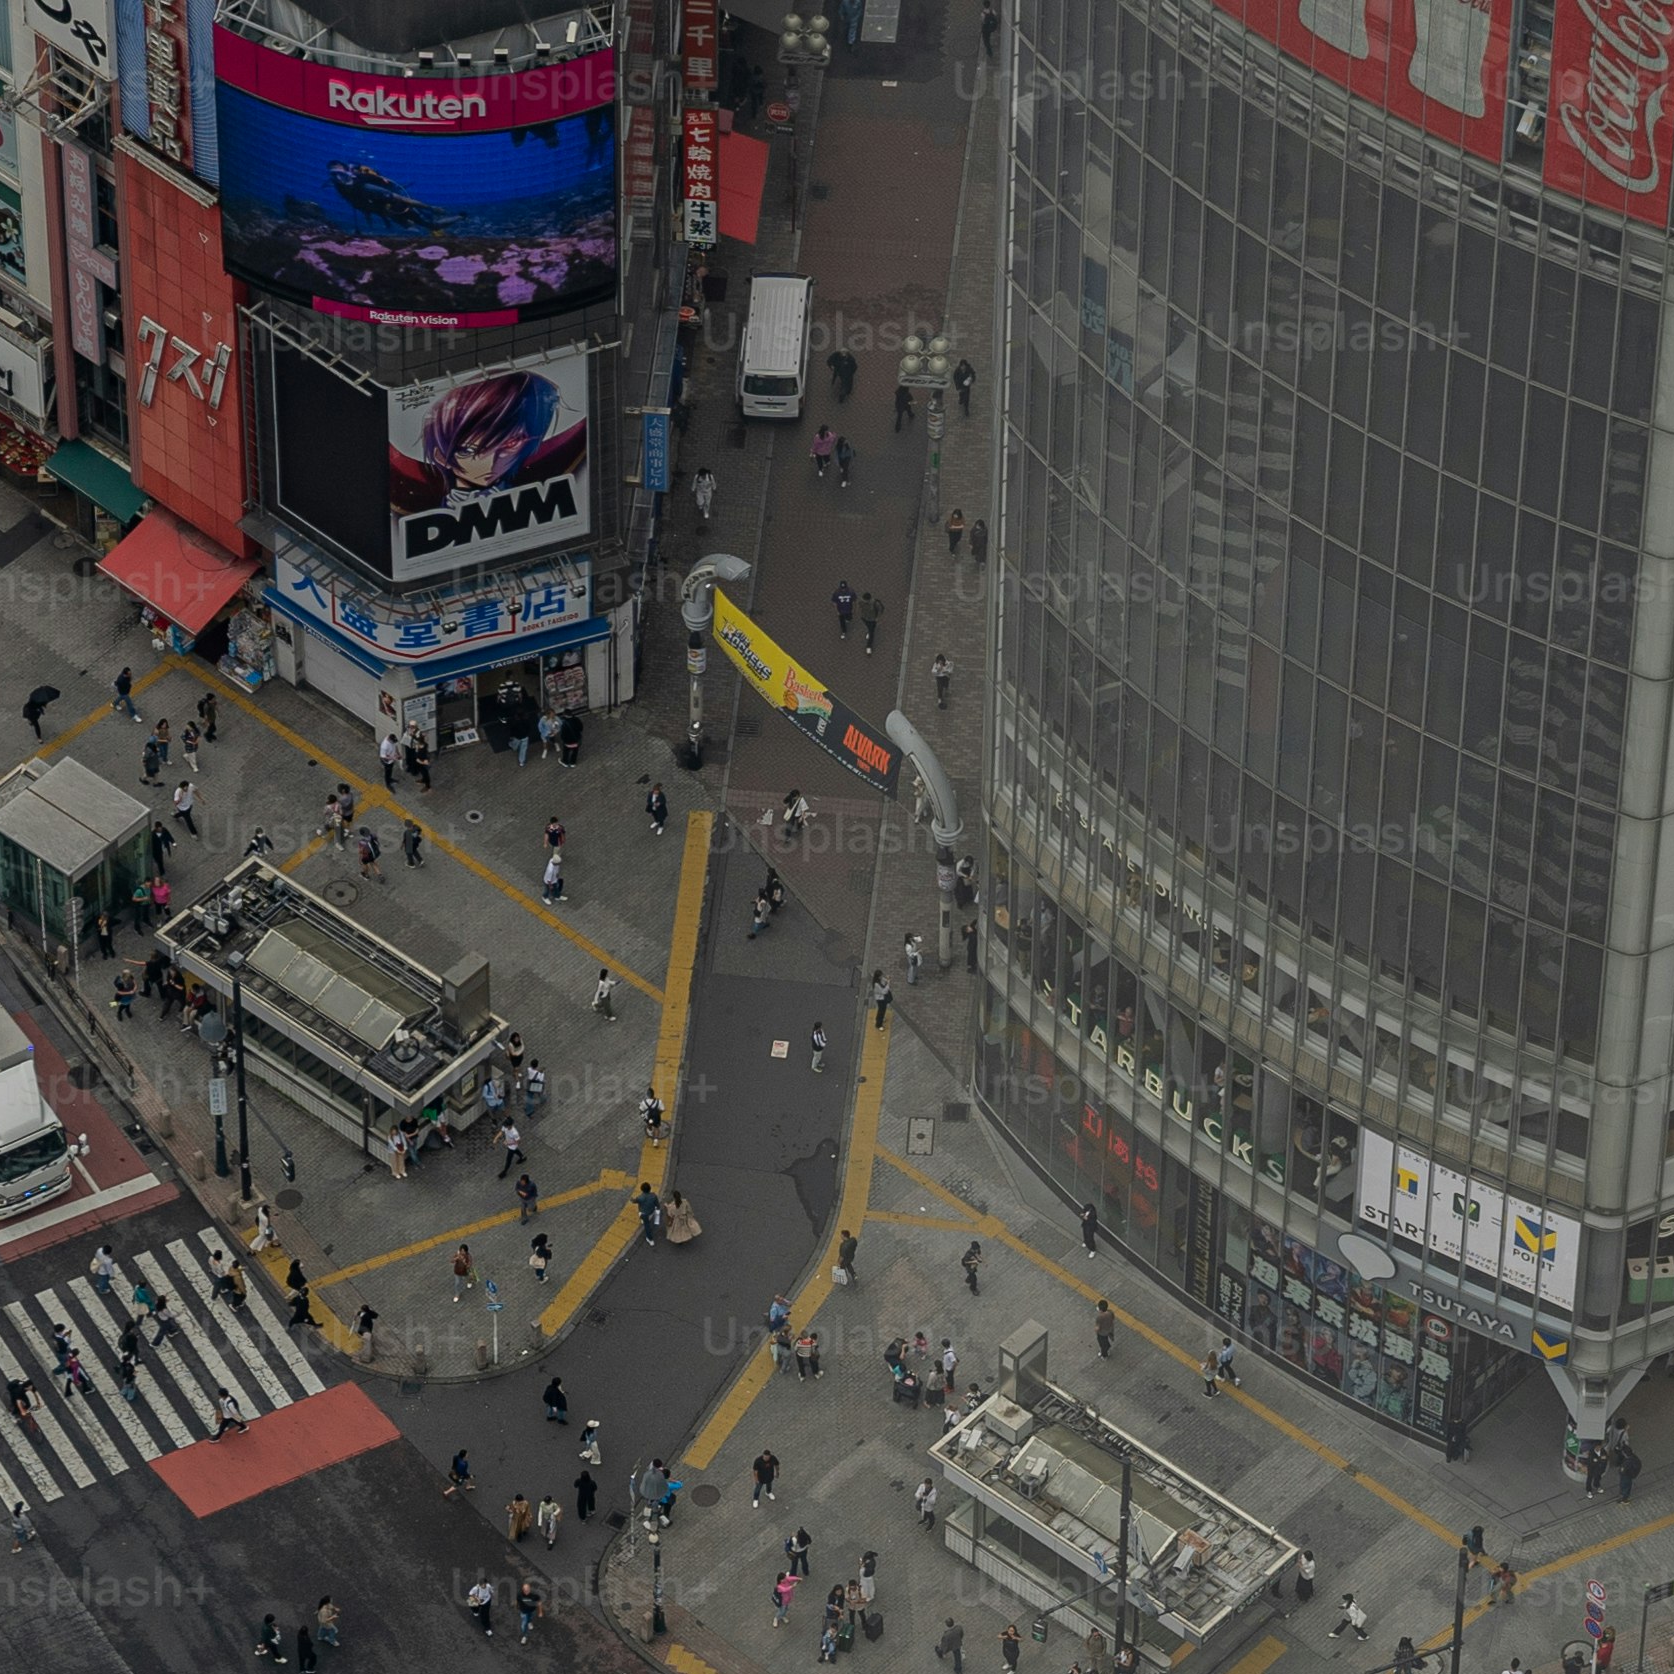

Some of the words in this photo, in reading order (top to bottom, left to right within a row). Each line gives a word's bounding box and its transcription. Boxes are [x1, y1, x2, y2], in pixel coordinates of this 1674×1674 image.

[328, 78, 486, 120] Rakuten
[687, 127, 713, 199] 七輪焼肉
[369, 310, 419, 325] Rakuten
[420, 314, 458, 325] Vision
[405, 478, 578, 560] DMM
[490, 652, 539, 670] TAISEIDO
[1408, 1281, 1516, 1339] TSUTAYA
